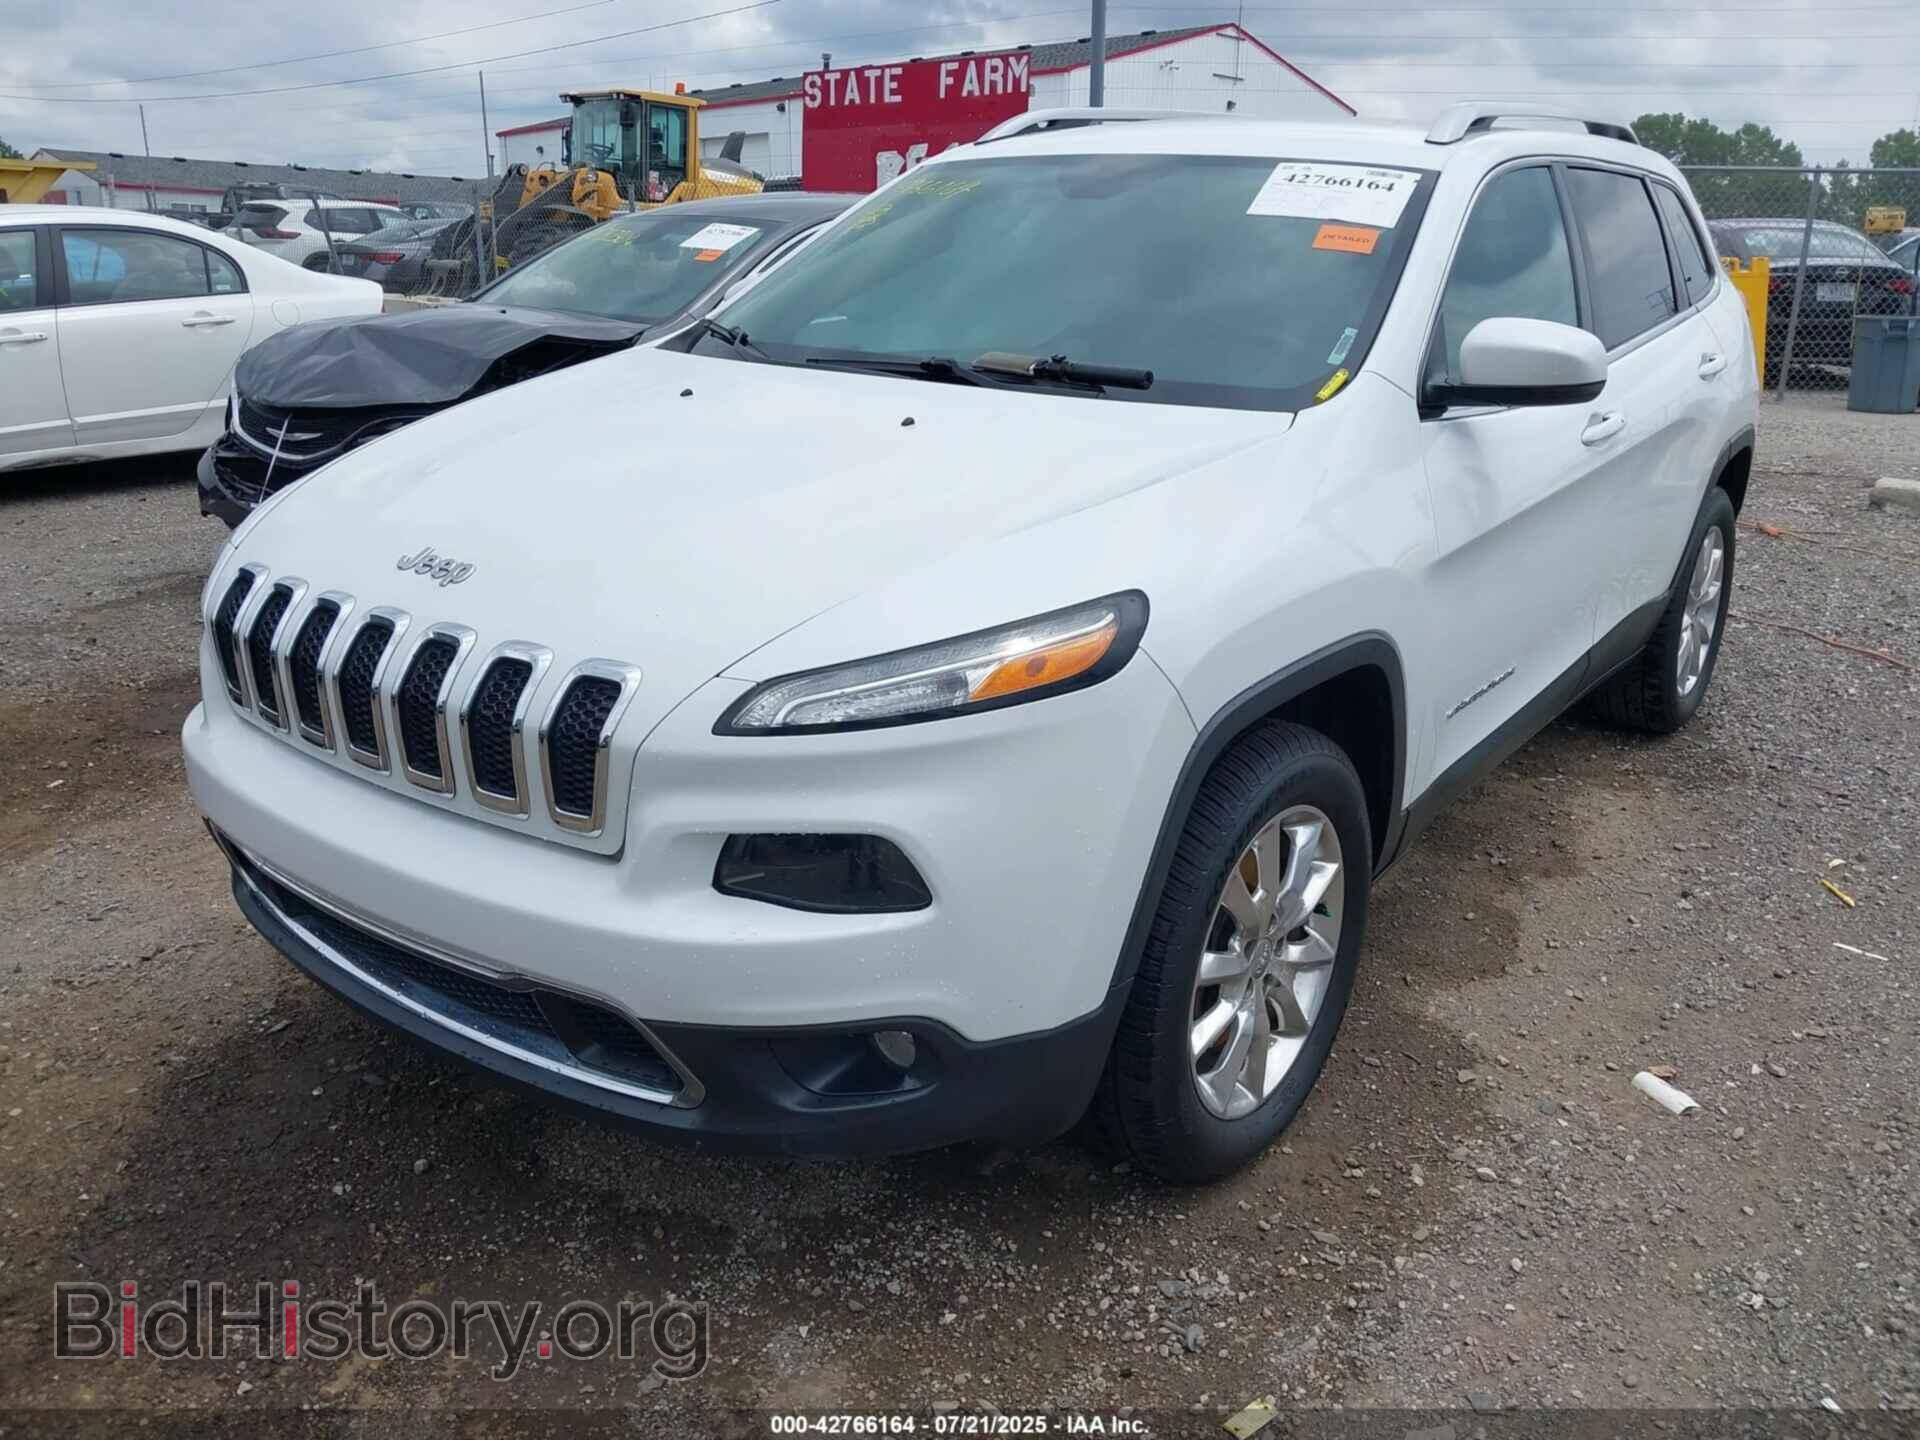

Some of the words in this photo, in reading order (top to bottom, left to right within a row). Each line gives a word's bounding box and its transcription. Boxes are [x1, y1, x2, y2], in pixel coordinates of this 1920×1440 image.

[804, 67, 903, 109] STATE
[939, 55, 1029, 99] FARM
[1283, 173, 1396, 193] 42766164
[396, 546, 476, 587] Jeep
